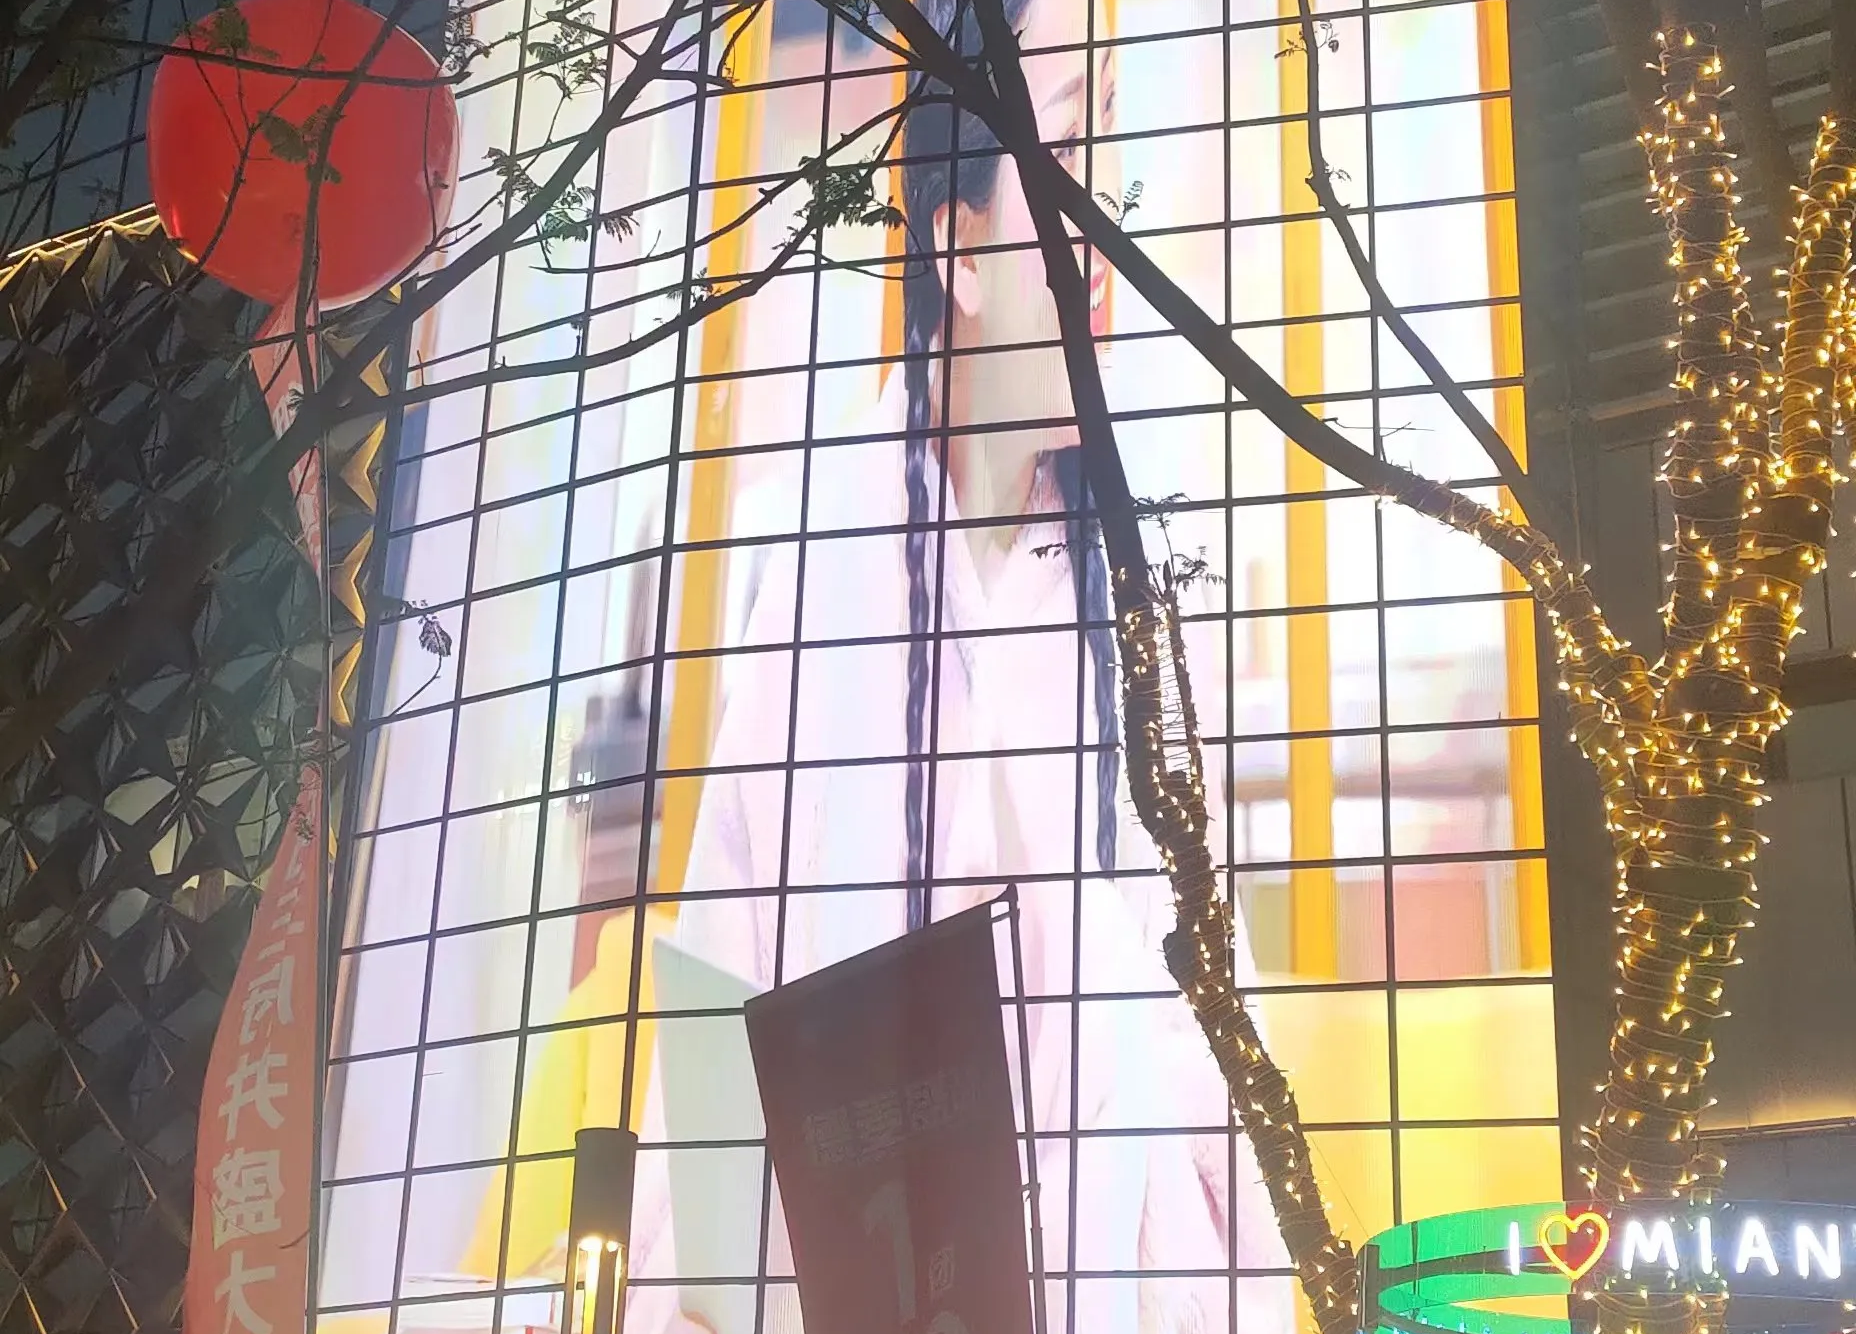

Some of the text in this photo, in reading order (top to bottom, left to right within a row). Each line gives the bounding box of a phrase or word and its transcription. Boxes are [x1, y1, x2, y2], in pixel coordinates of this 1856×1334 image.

[863, 1179, 917, 1325] 1
[1509, 1216, 1856, 1280] I MIAN
